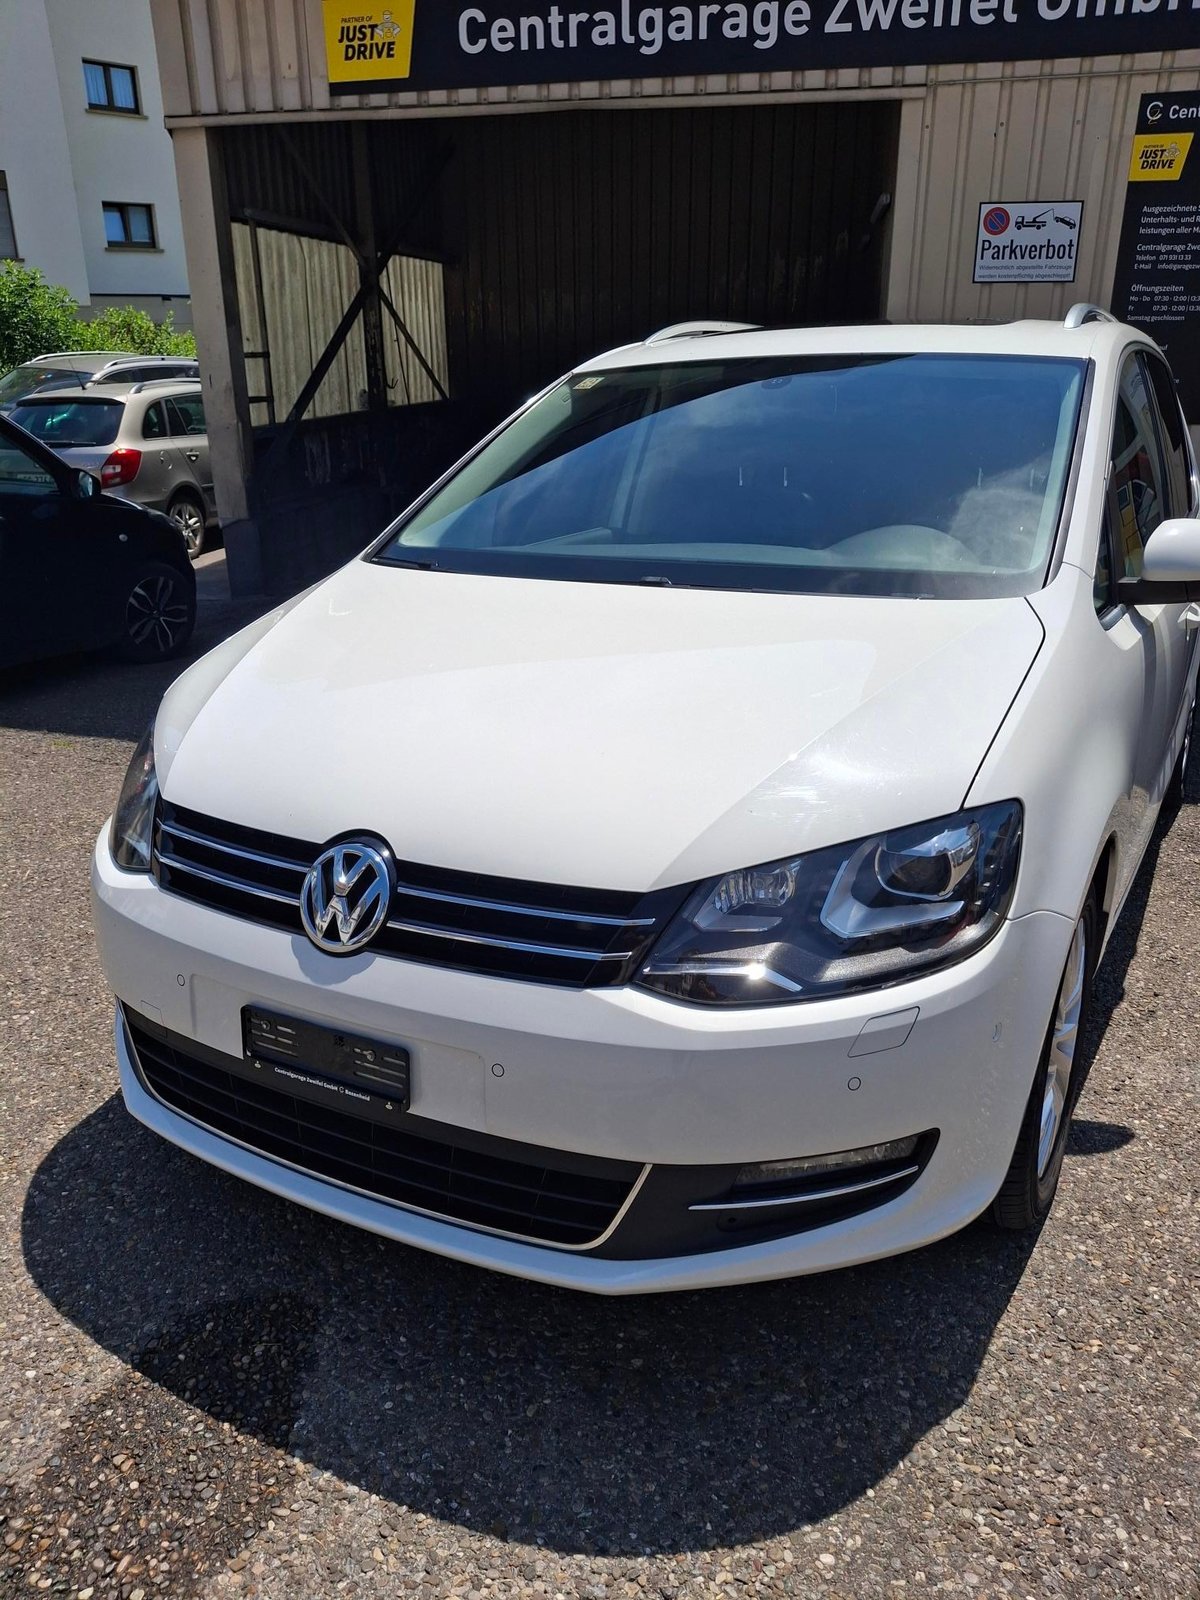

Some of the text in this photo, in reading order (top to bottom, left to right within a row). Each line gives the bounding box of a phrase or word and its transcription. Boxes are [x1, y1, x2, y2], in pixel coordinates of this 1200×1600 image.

[458, 0, 811, 55] Centralgarage
[338, 24, 379, 43] JUST
[344, 41, 395, 61] DRIVE
[1139, 149, 1166, 160] JUST
[1141, 159, 1175, 170] DRIVE
[1142, 204, 1198, 215] Ausgezeichnete
[1181, 215, 1195, 223] und
[1139, 227, 1175, 236] leistungen
[1175, 226, 1192, 234] aller
[980, 239, 1074, 260] Parkverbot
[1136, 243, 1186, 252] Centralgarage
